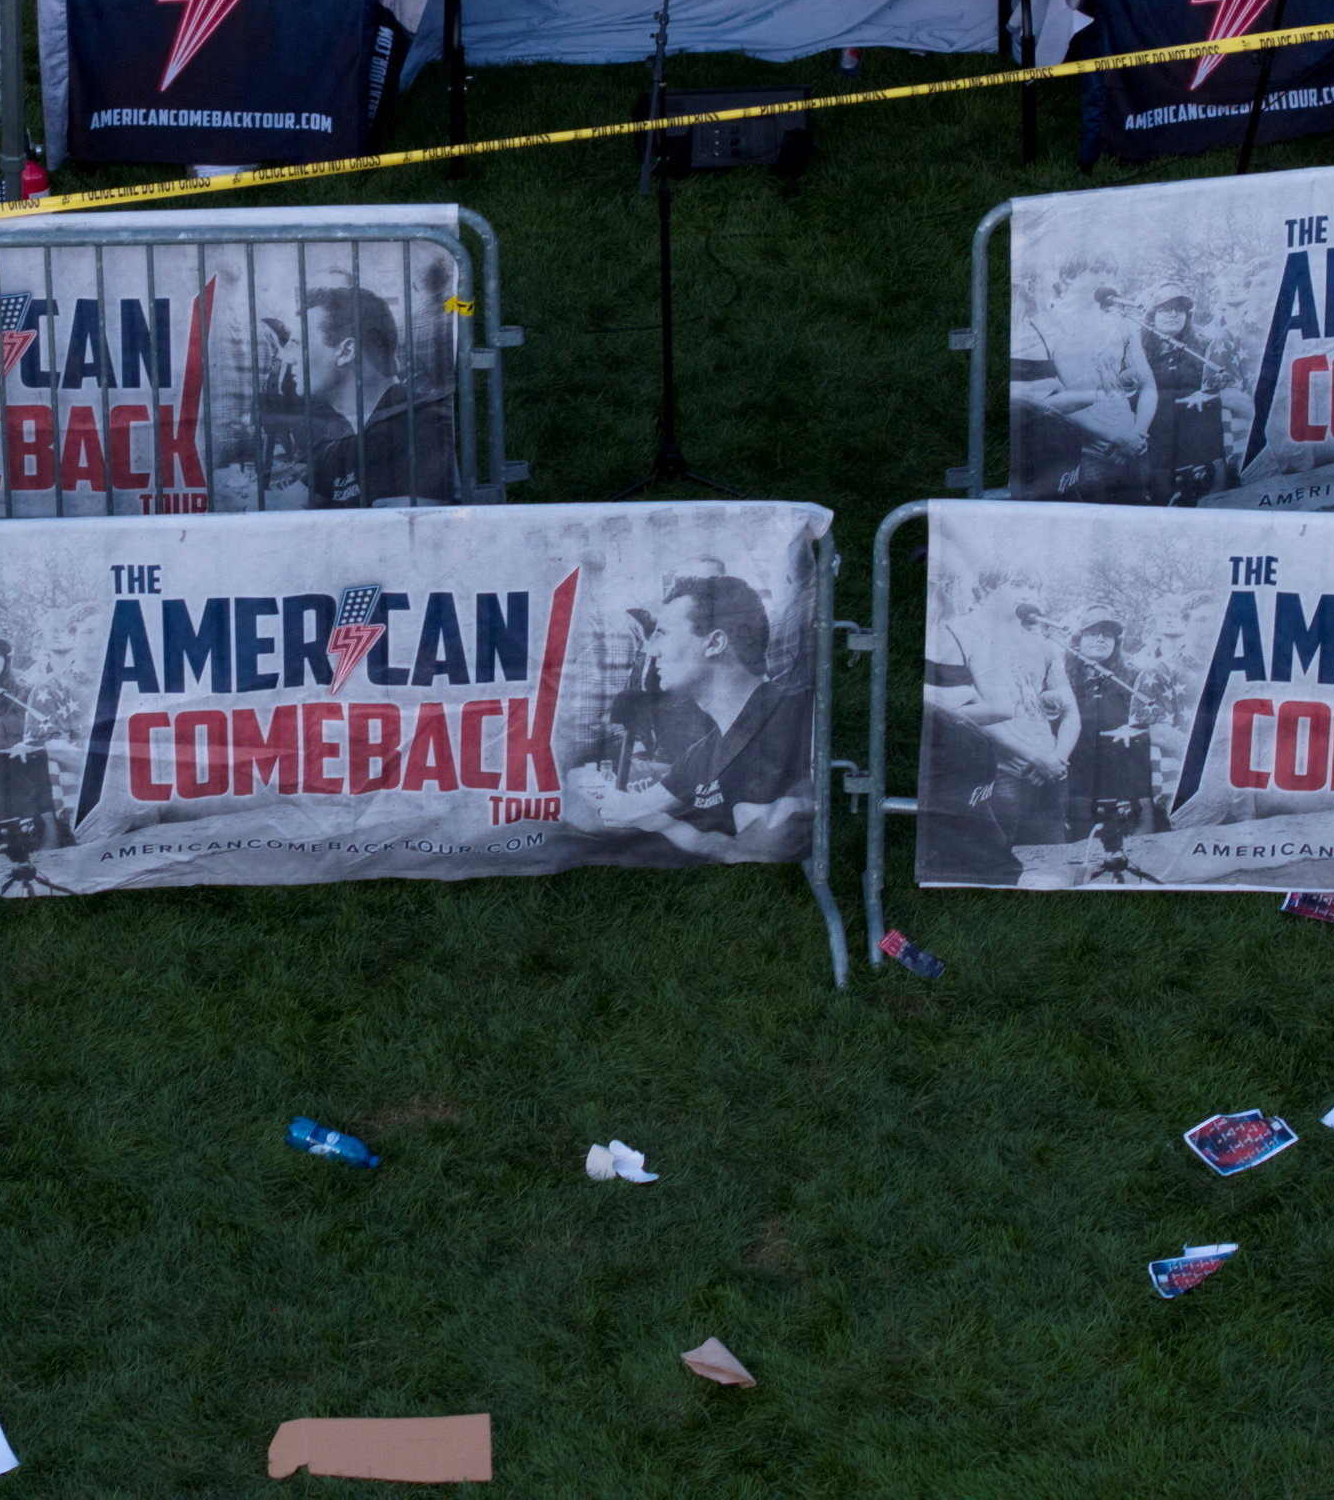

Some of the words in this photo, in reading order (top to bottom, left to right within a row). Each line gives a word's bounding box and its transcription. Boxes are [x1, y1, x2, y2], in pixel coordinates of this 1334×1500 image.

[1094, 57, 1127, 72] POLICE
[1129, 54, 1150, 68] LINE
[1152, 51, 1167, 64] DO
[1168, 49, 1187, 62] NOT
[89, 107, 333, 135] AMERICANCOMEBACKTOUR.COM
[252, 166, 286, 181] POLICE
[288, 163, 309, 177] LINE
[312, 161, 326, 174] DO
[328, 158, 346, 172] NOT
[348, 155, 381, 169] CROSS
[118, 185, 138, 197] LINE
[141, 183, 155, 194] DO
[1284, 215, 1328, 248] THE
[110, 564, 161, 595] THE
[1229, 555, 1279, 586] THE
[128, 566, 580, 802] COMEBACK
[73, 583, 530, 832] AMERICAN
[490, 796, 561, 825] TOUR
[100, 832, 545, 863] AMERICANCOMEBACKTOUR.COM
